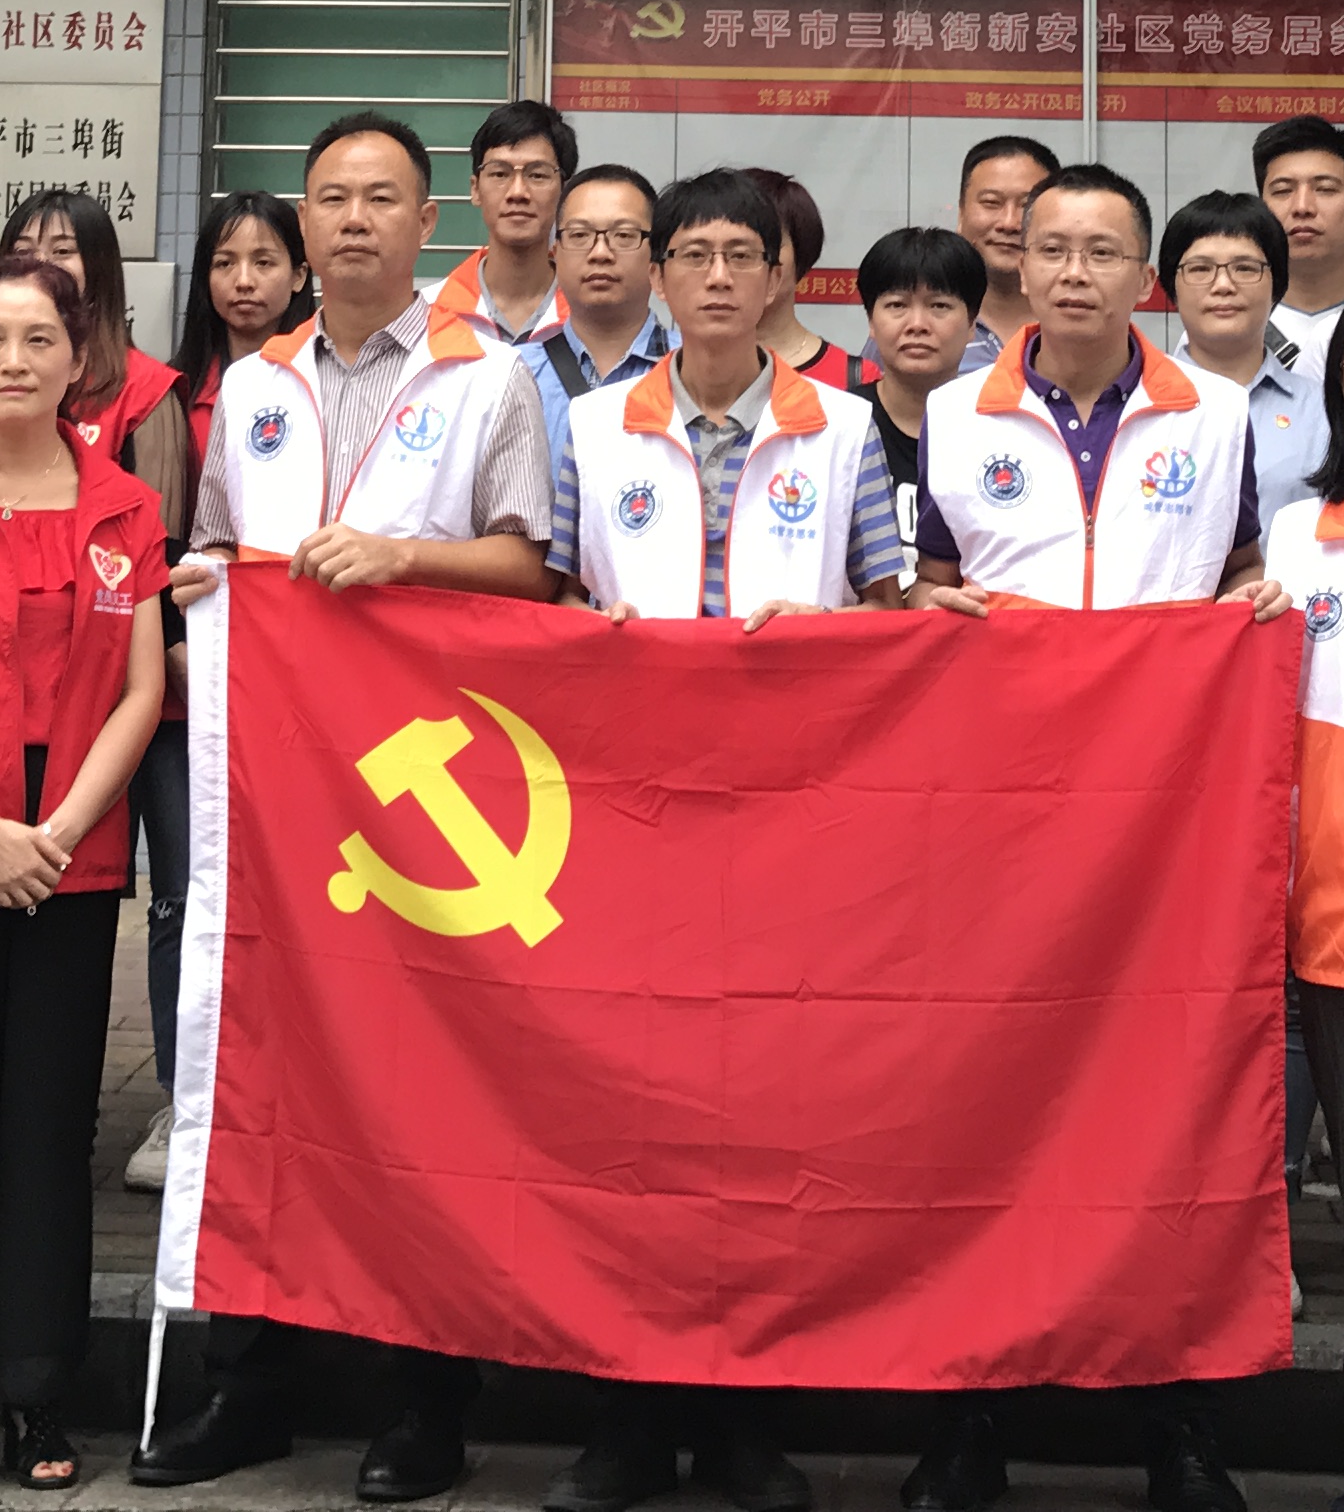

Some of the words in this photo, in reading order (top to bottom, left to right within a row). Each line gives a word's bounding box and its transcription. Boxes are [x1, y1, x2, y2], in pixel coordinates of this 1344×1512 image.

[757, 88, 831, 108] 党务公开
[965, 91, 1127, 113] 政务公开(及时开)
